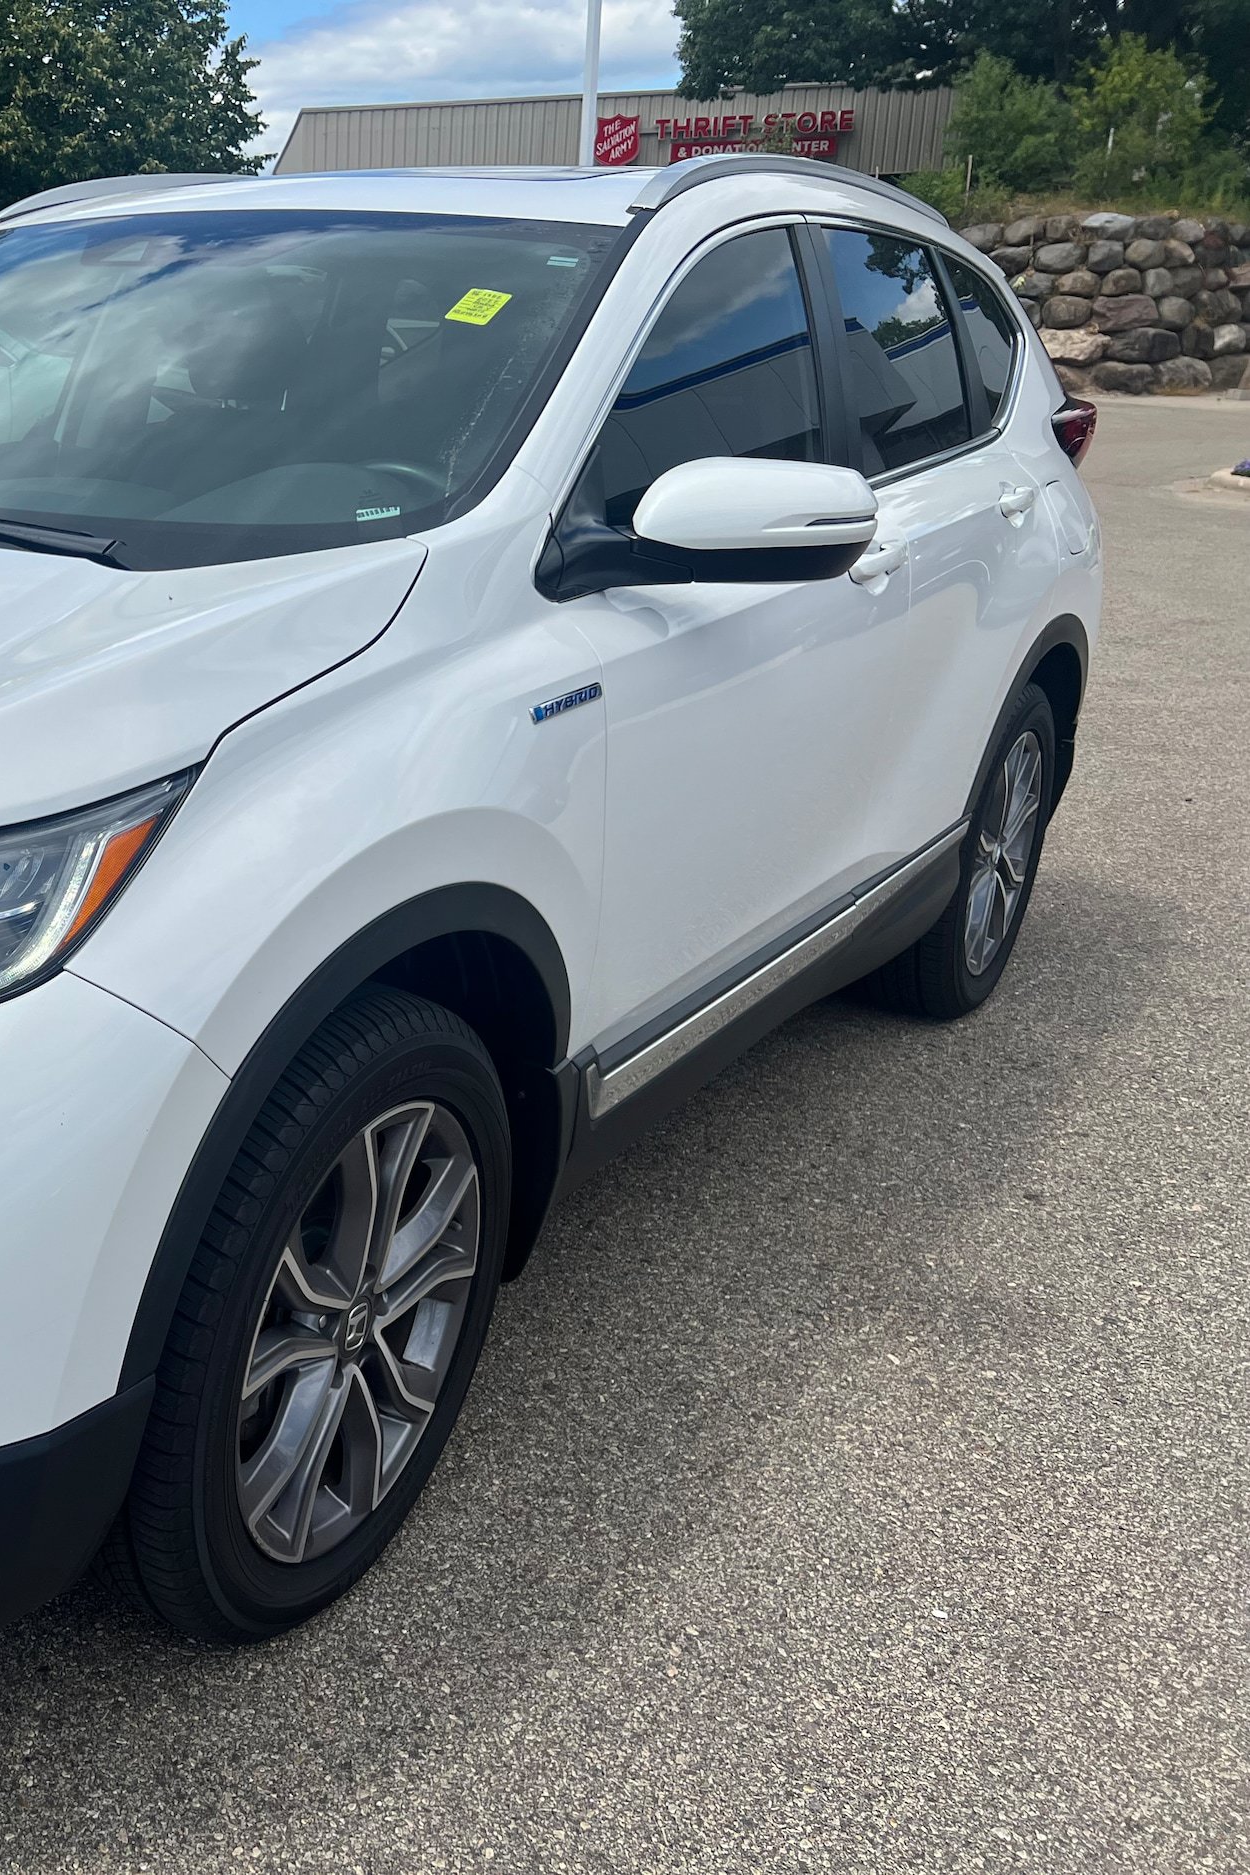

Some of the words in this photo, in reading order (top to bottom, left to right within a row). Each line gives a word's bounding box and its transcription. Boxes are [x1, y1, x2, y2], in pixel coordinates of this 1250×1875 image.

[596, 120, 636, 156] SALVATION
[603, 119, 622, 138] THE
[654, 114, 755, 141] THRIFT
[761, 109, 855, 136] STORE
[609, 135, 634, 163] ARMY
[677, 145, 687, 158] &
[780, 139, 830, 154] NTER
[544, 686, 598, 718] HYBRID
